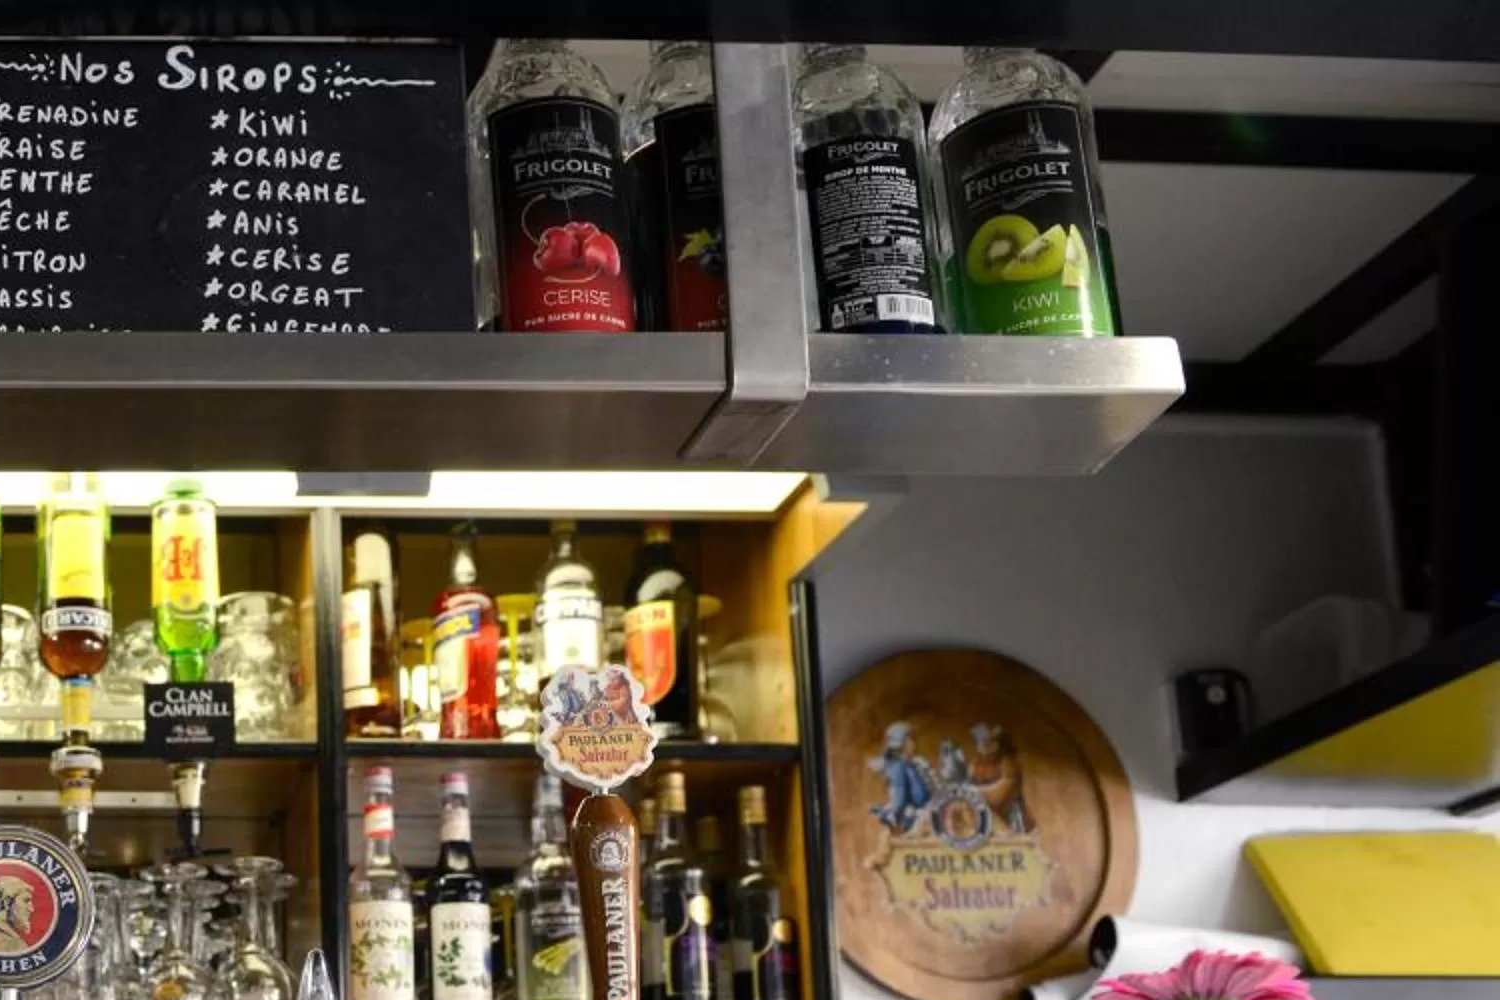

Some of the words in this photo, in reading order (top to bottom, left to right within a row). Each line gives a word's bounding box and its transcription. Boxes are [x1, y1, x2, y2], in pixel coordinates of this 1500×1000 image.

[233, 146, 344, 172] ORANGE
[514, 158, 614, 183] FRIGOLET
[232, 179, 367, 205] CARAMEL
[963, 160, 1071, 202] FRIGOLET
[227, 279, 365, 308] ORGEAT
[542, 289, 613, 308] CERISE
[1012, 292, 1061, 312] KIWI
[165, 687, 214, 704] CLAN
[148, 701, 232, 718] CAMPBELL
[568, 733, 633, 747] PAULANER
[903, 850, 1027, 875] PAULANER
[923, 878, 1017, 909] Salvator
